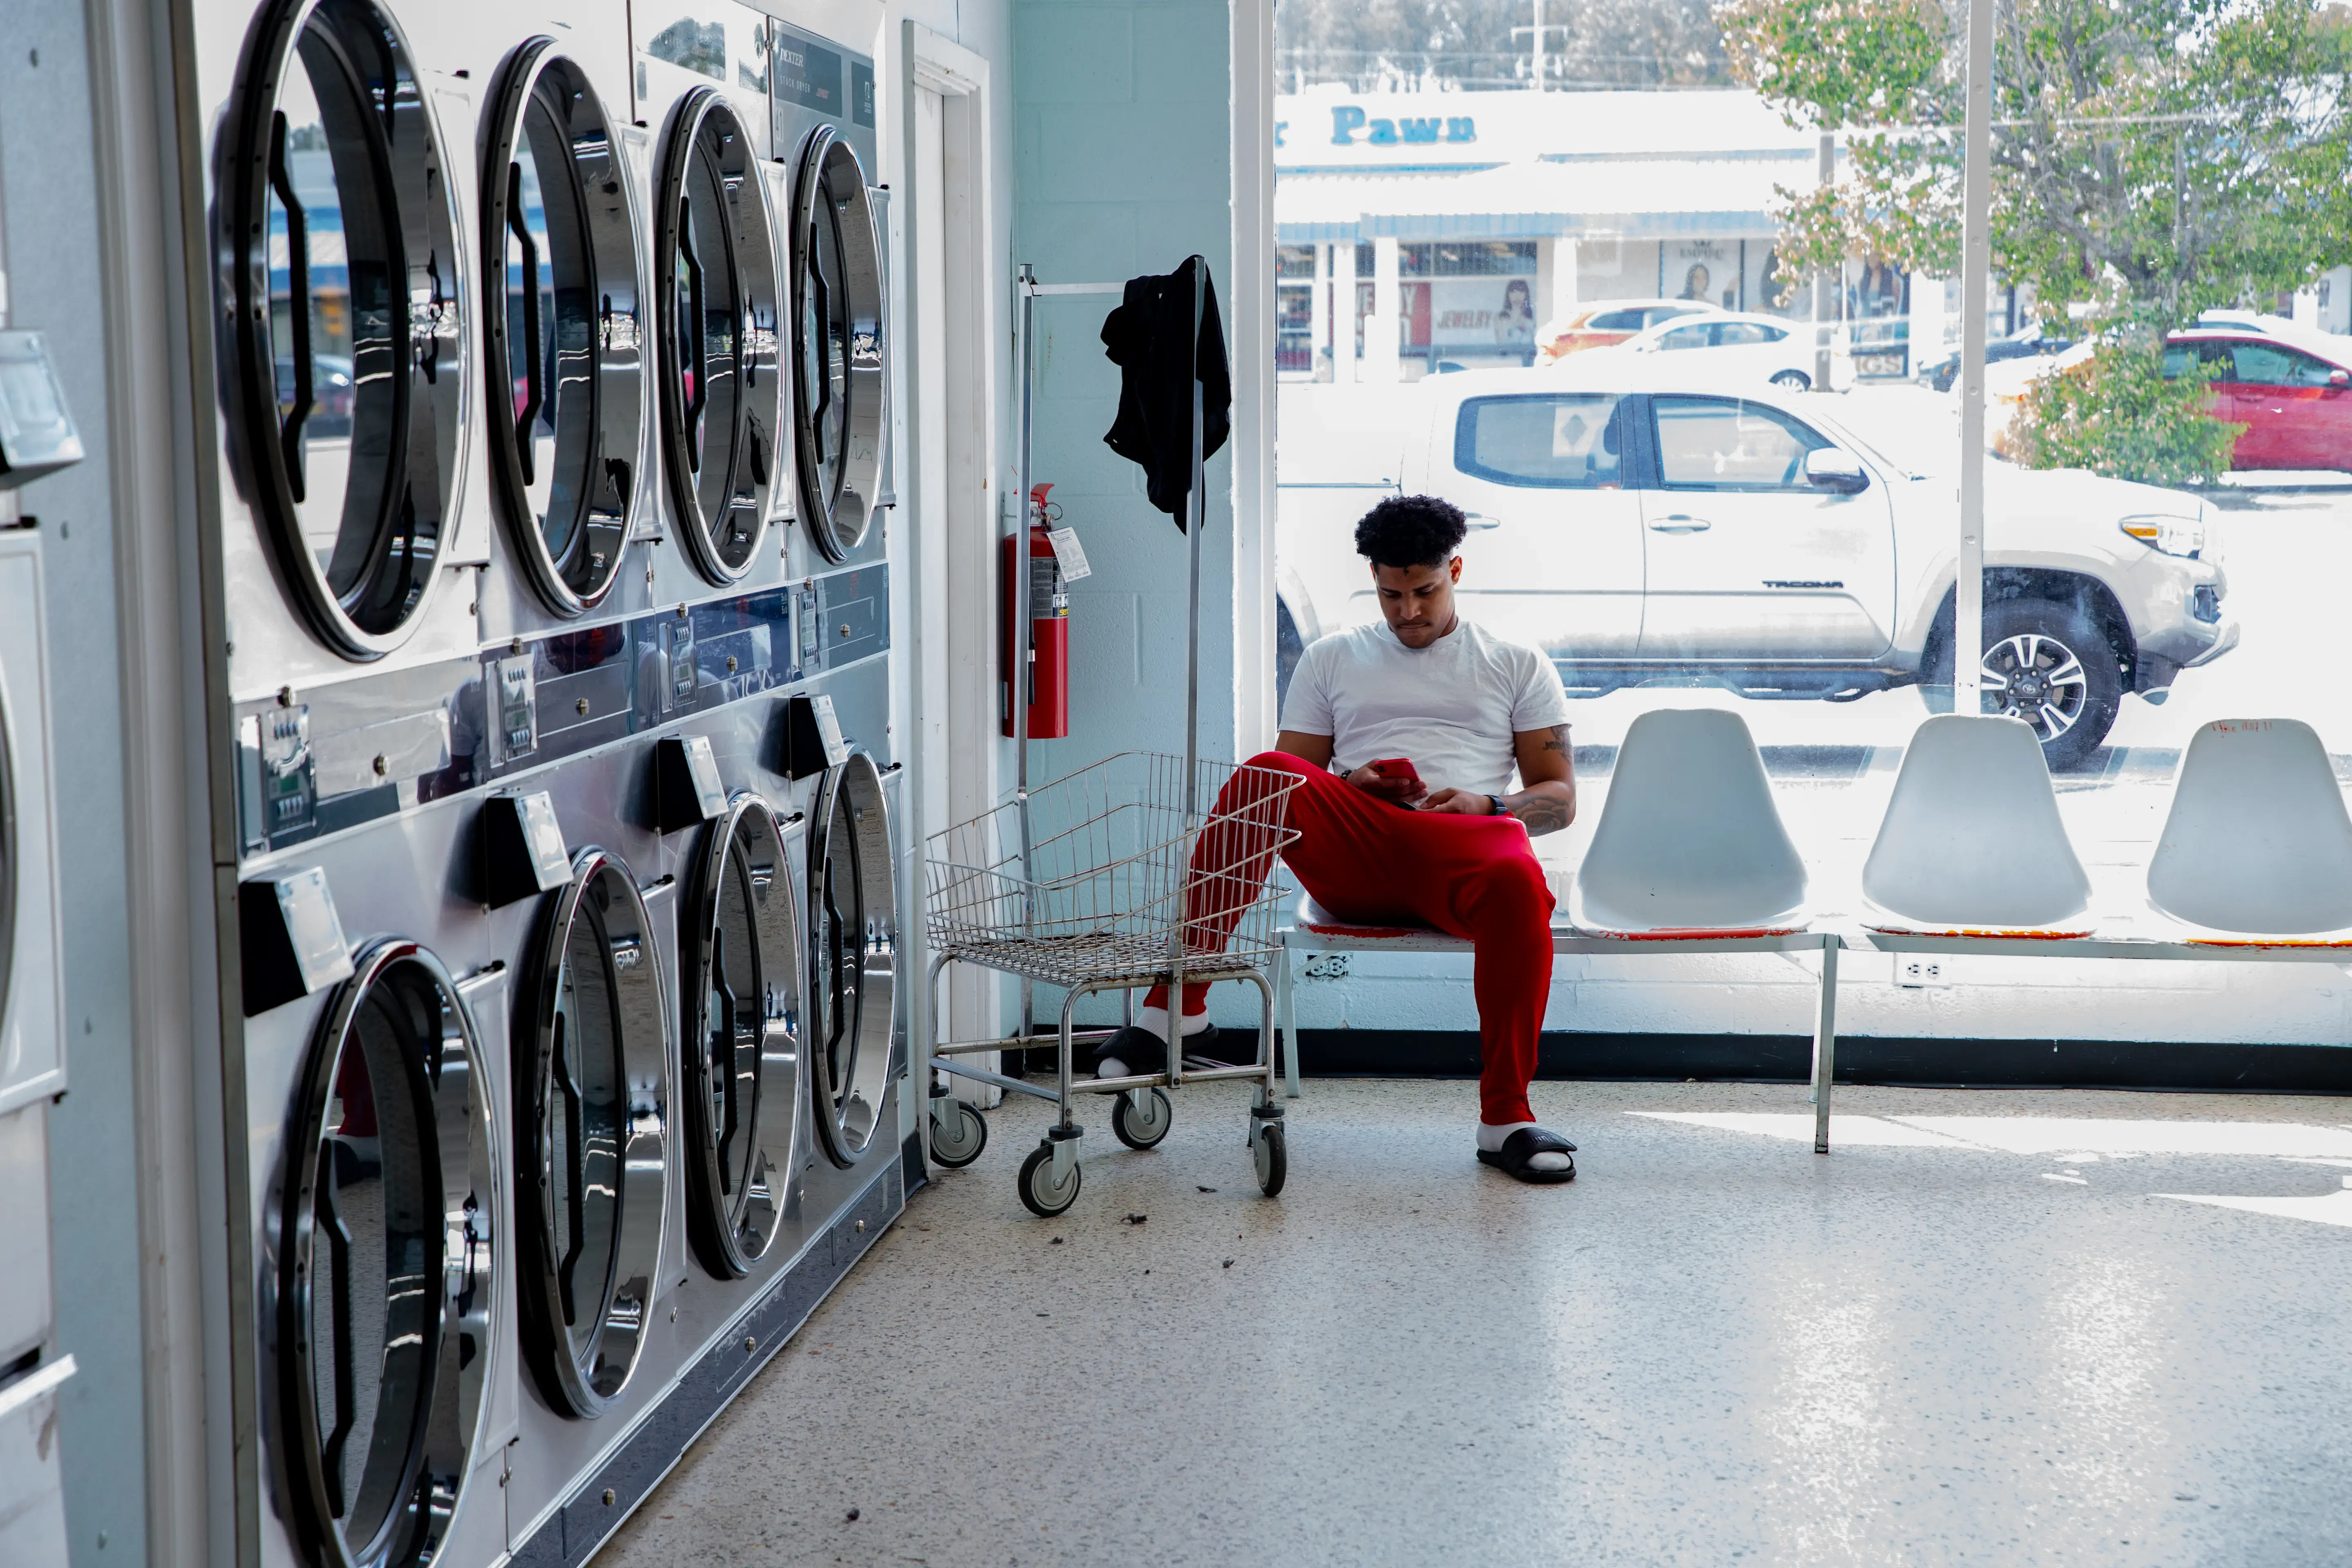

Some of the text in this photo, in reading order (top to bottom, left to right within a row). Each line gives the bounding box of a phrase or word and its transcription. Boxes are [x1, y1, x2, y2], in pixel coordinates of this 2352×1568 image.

[780, 47, 804, 67] DEXTER
[780, 75, 795, 89] STACK
[796, 80, 811, 94] DRYER
[1330, 105, 1477, 146] Pawn
[1437, 310, 1492, 329] JEWELRY
[1854, 354, 1900, 374] IGS
[1762, 580, 1844, 588] TACOMA
